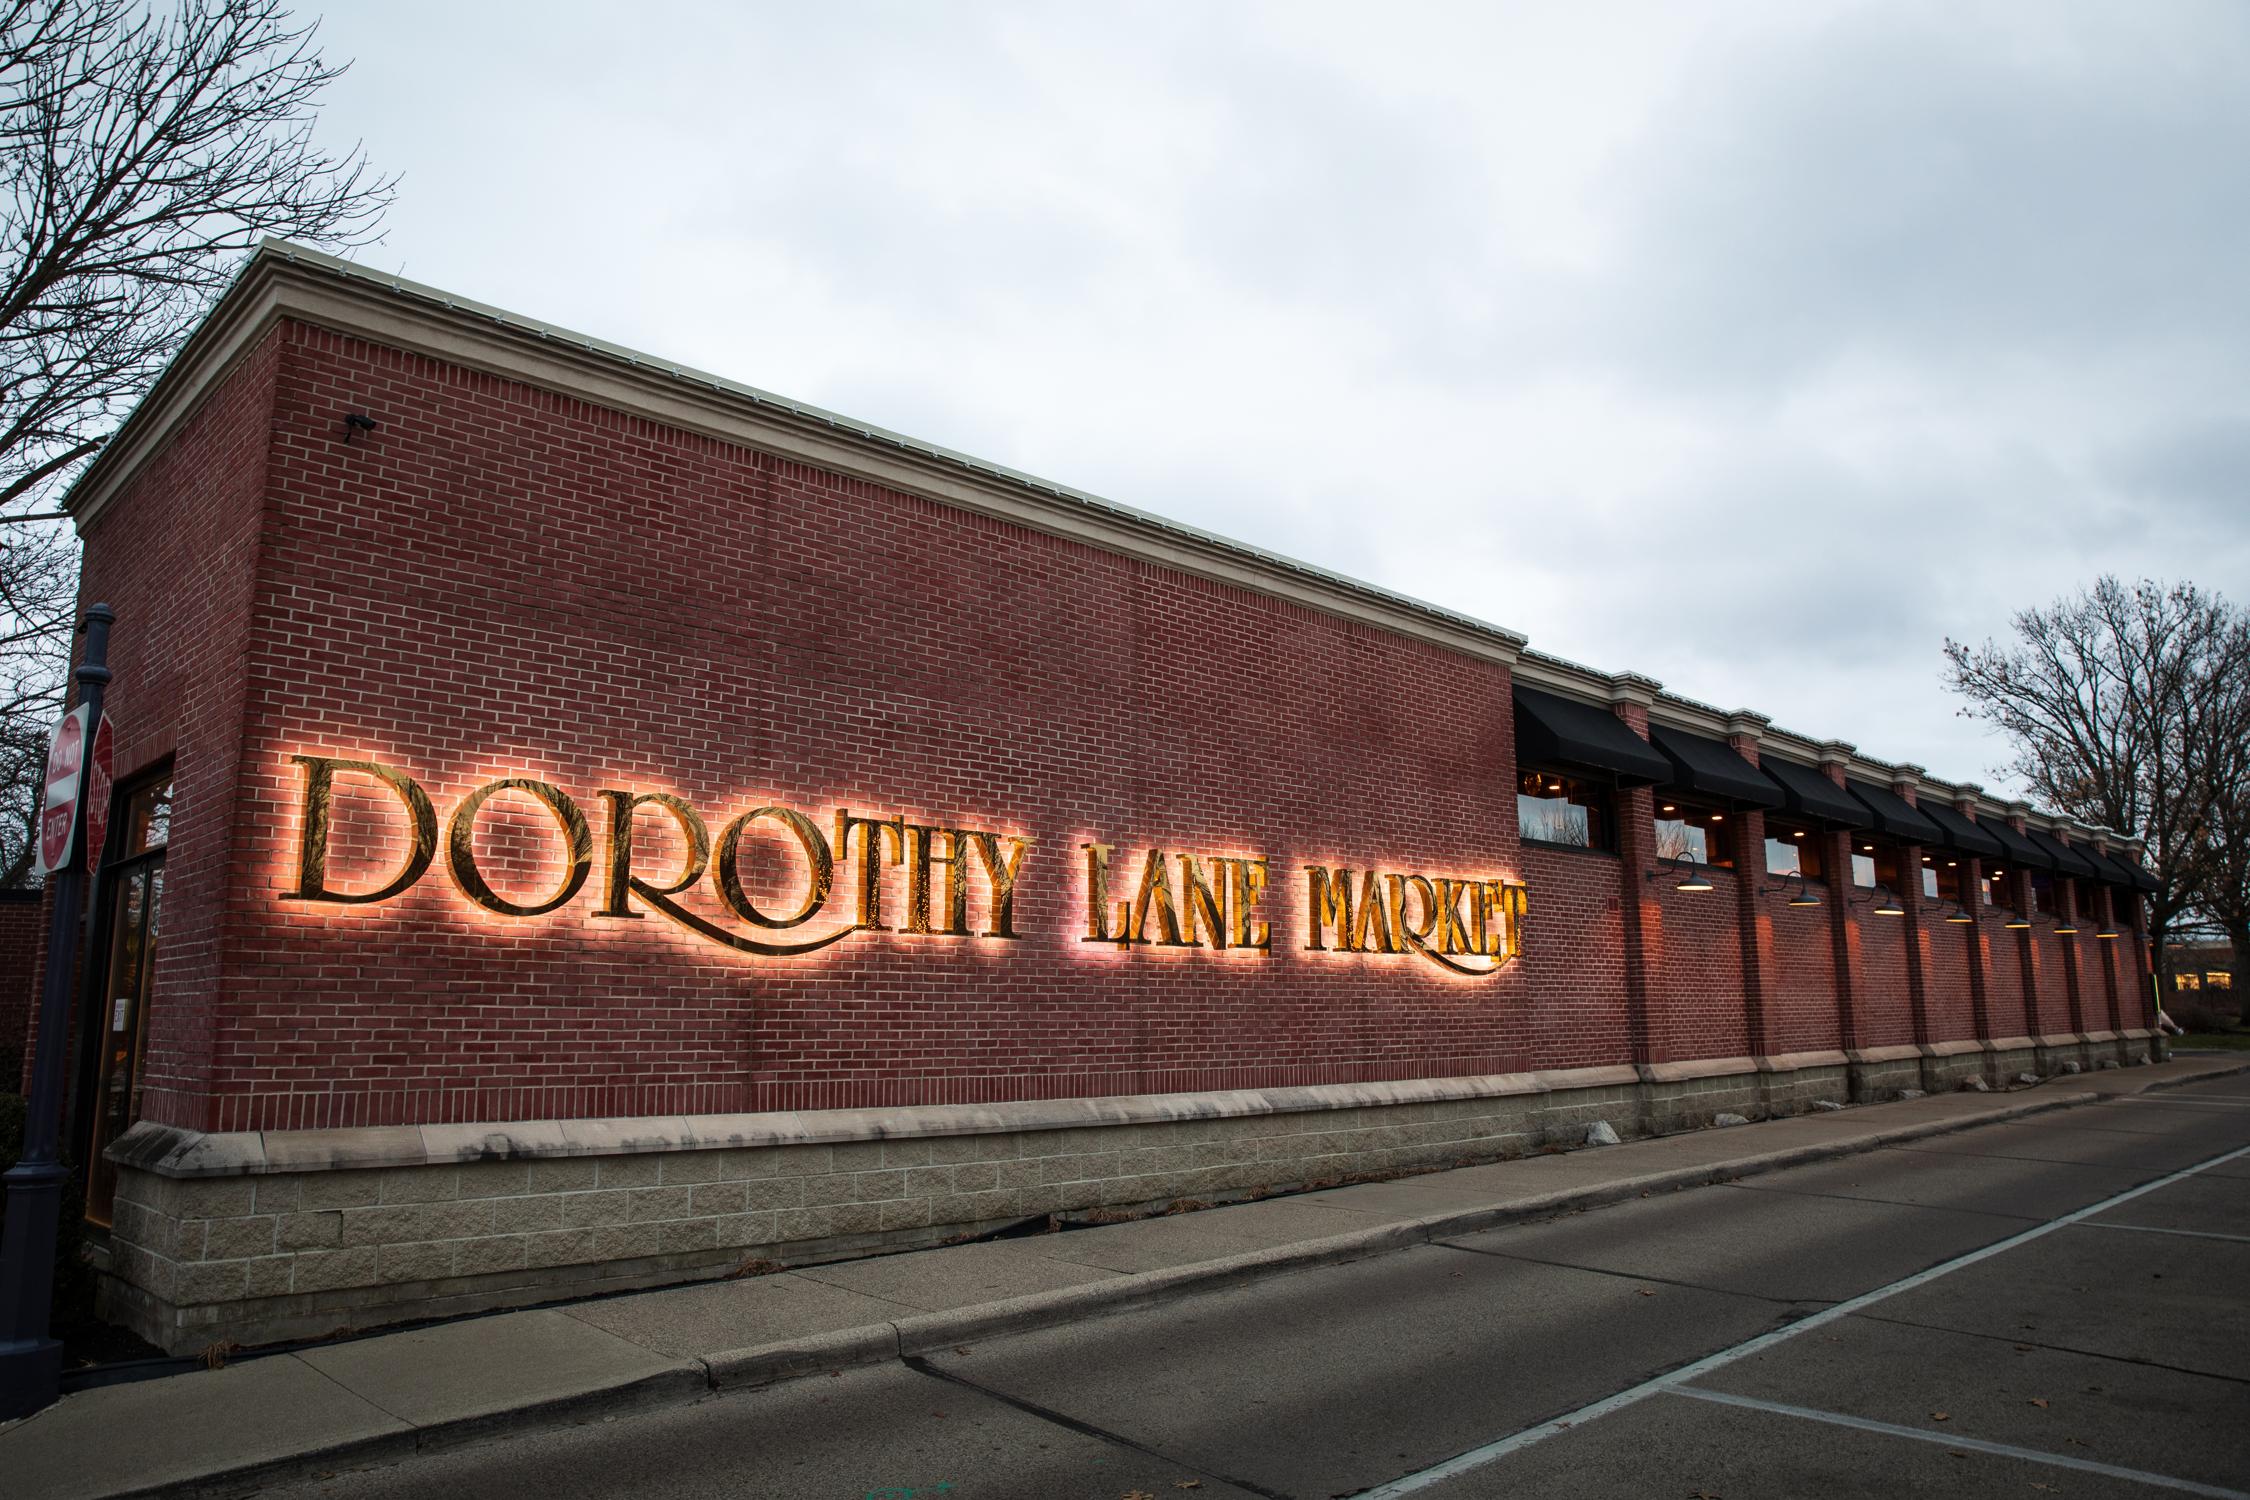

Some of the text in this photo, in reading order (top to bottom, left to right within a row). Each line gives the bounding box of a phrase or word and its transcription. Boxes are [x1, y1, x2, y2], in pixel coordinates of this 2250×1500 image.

[52, 740, 80, 773] DO NOT
[89, 760, 111, 829] STOP
[46, 812, 69, 841] ENTER
[278, 754, 1529, 977] DOROTHY LANE MARKET
